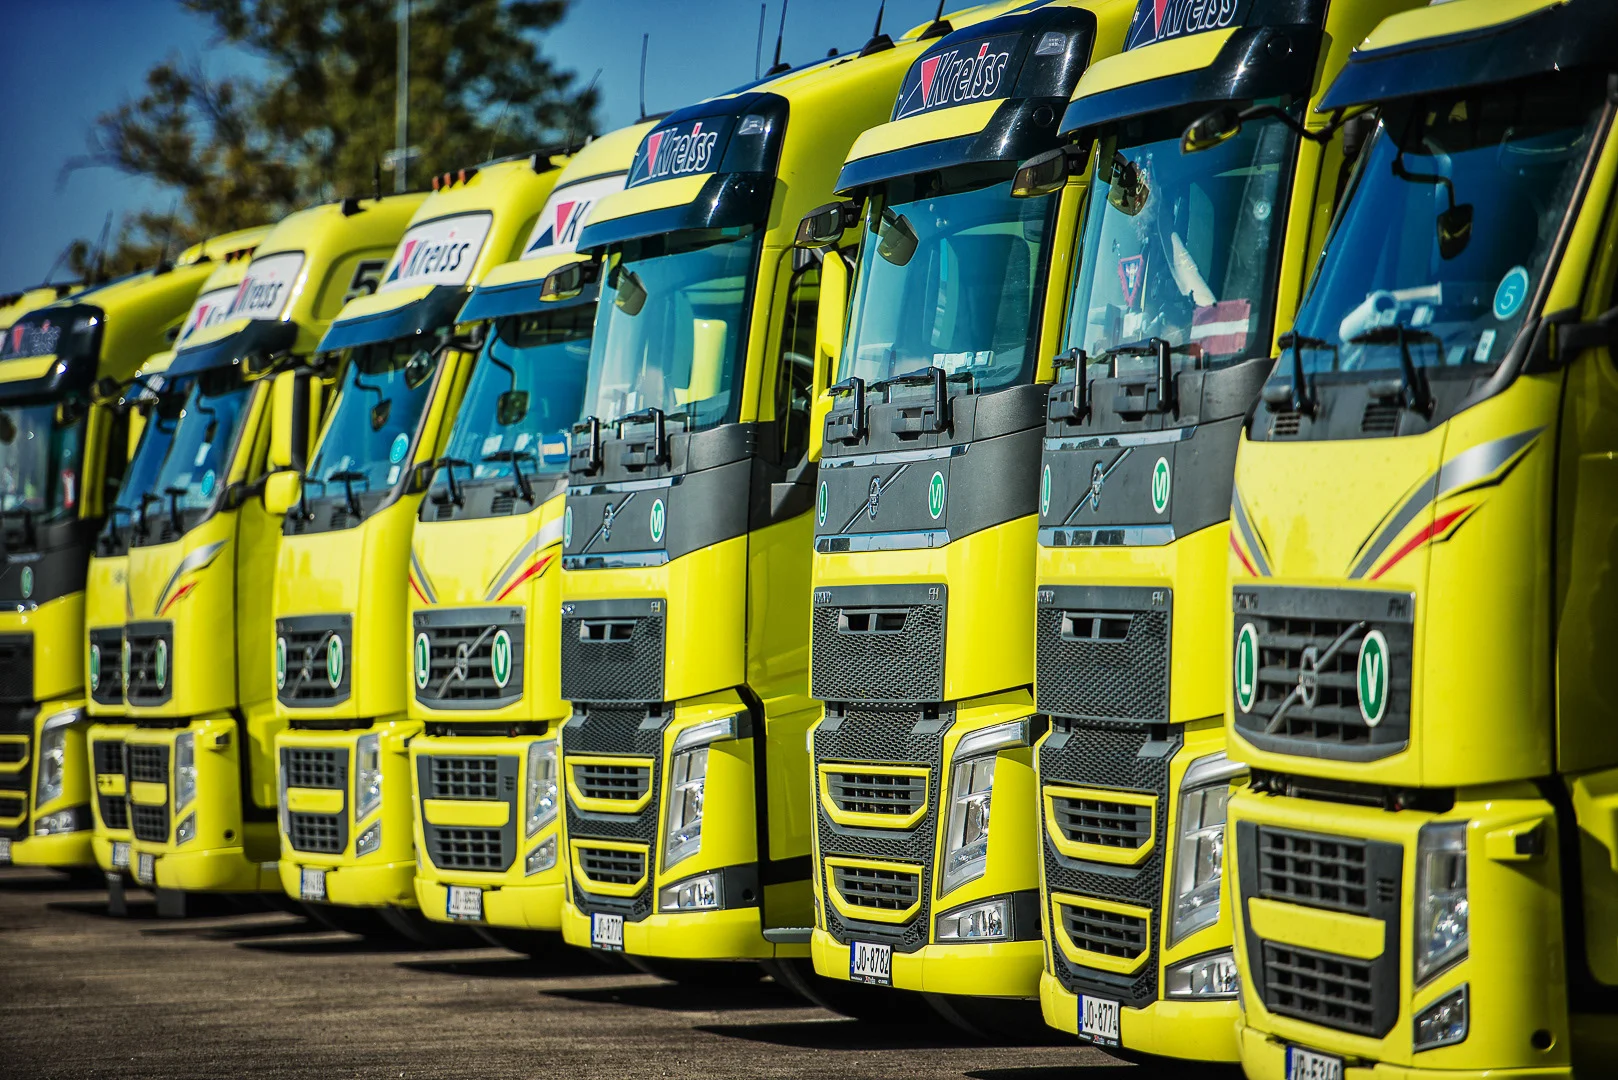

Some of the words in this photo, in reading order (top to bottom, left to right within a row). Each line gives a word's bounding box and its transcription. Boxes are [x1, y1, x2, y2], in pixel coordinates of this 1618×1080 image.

[927, 42, 1009, 109] Kreiss
[651, 121, 718, 178] Kreiss
[403, 231, 470, 277] Kreiss
[1500, 285, 1517, 310] 5
[931, 483, 941, 509] VI
[1155, 470, 1167, 502] VI
[928, 587, 939, 601] FH
[1152, 591, 1165, 606] FH
[496, 643, 506, 675] V
[1240, 641, 1251, 695] L
[1364, 652, 1381, 705] V
[855, 945, 890, 975] JO-8782
